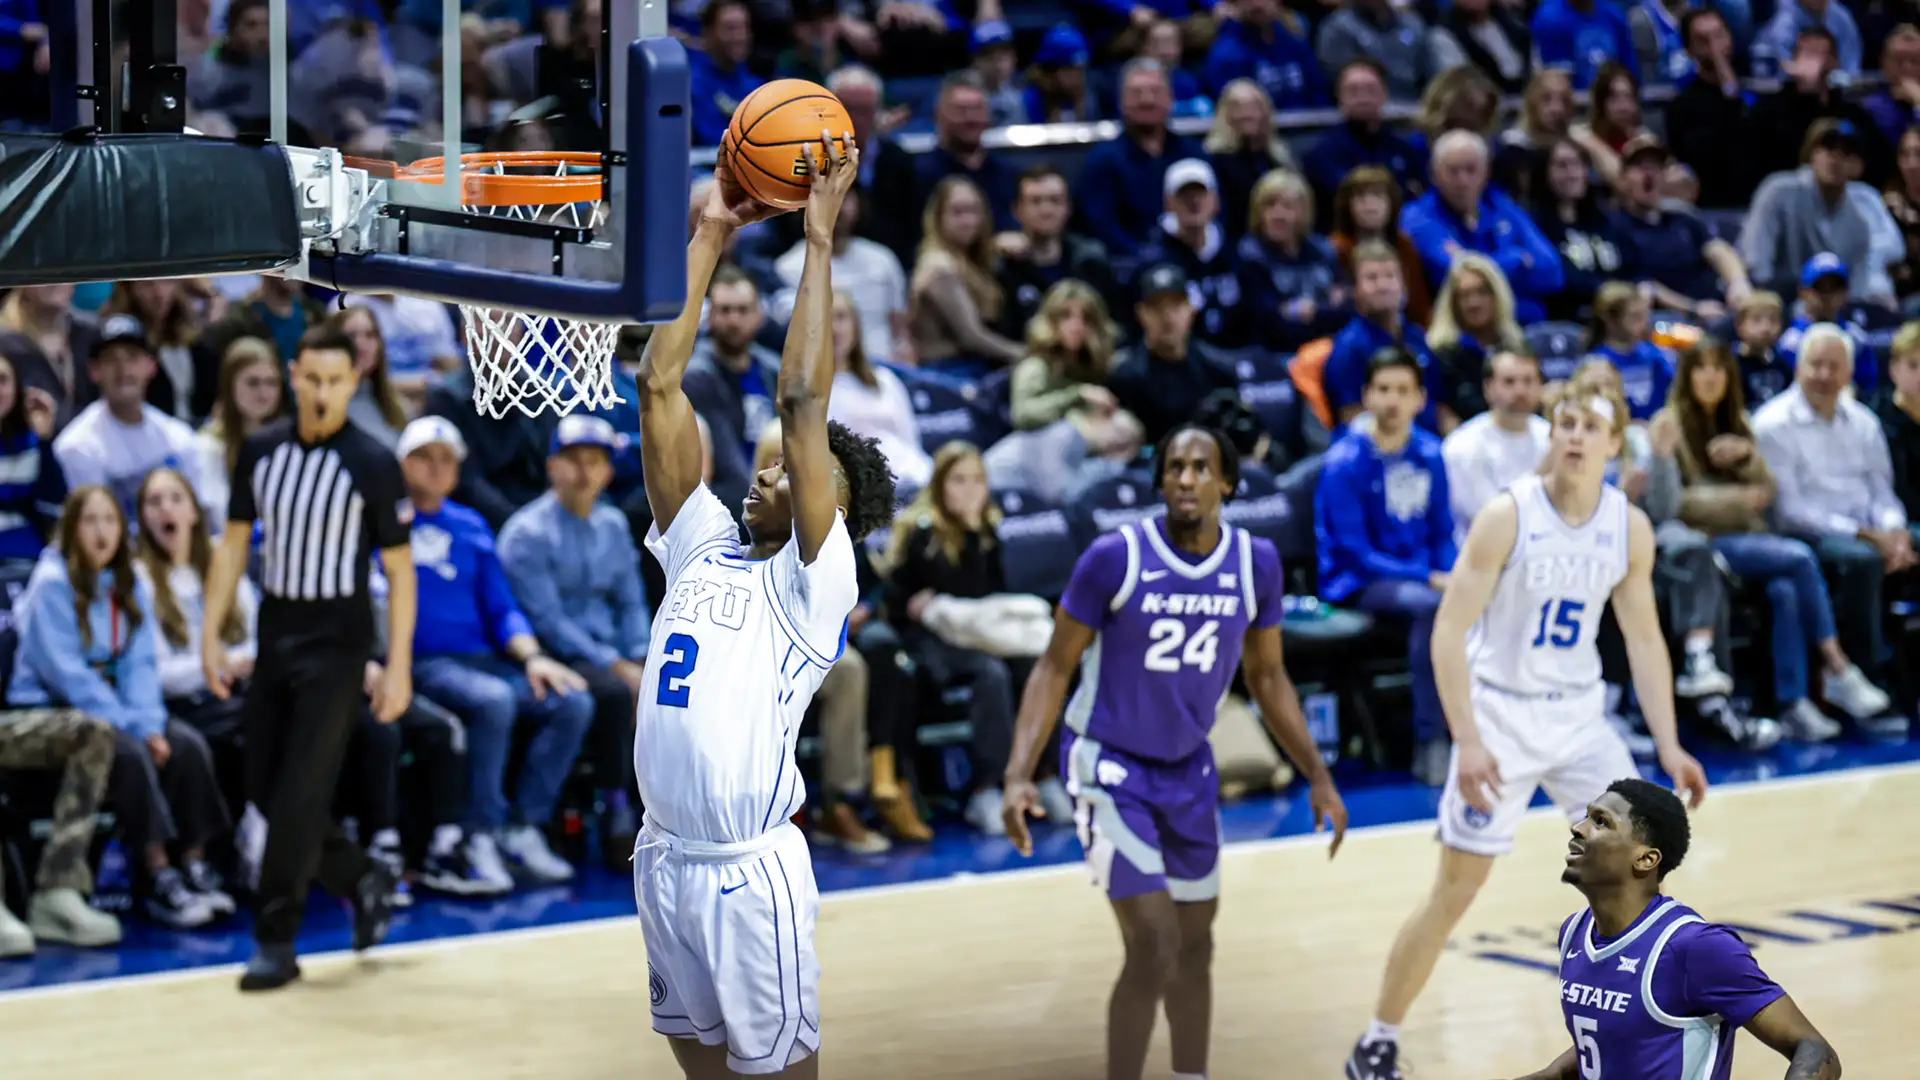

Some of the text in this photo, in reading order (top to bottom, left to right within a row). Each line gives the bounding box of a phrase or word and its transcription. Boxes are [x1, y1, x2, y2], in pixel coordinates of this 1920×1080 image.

[1524, 555, 1612, 592] BYU
[665, 578, 752, 631] BYU
[1141, 592, 1240, 616] K-STATE
[1532, 597, 1585, 649] 15
[656, 632, 700, 708] 2
[1144, 618, 1220, 673] 24
[1572, 1014, 1601, 1080] 5
